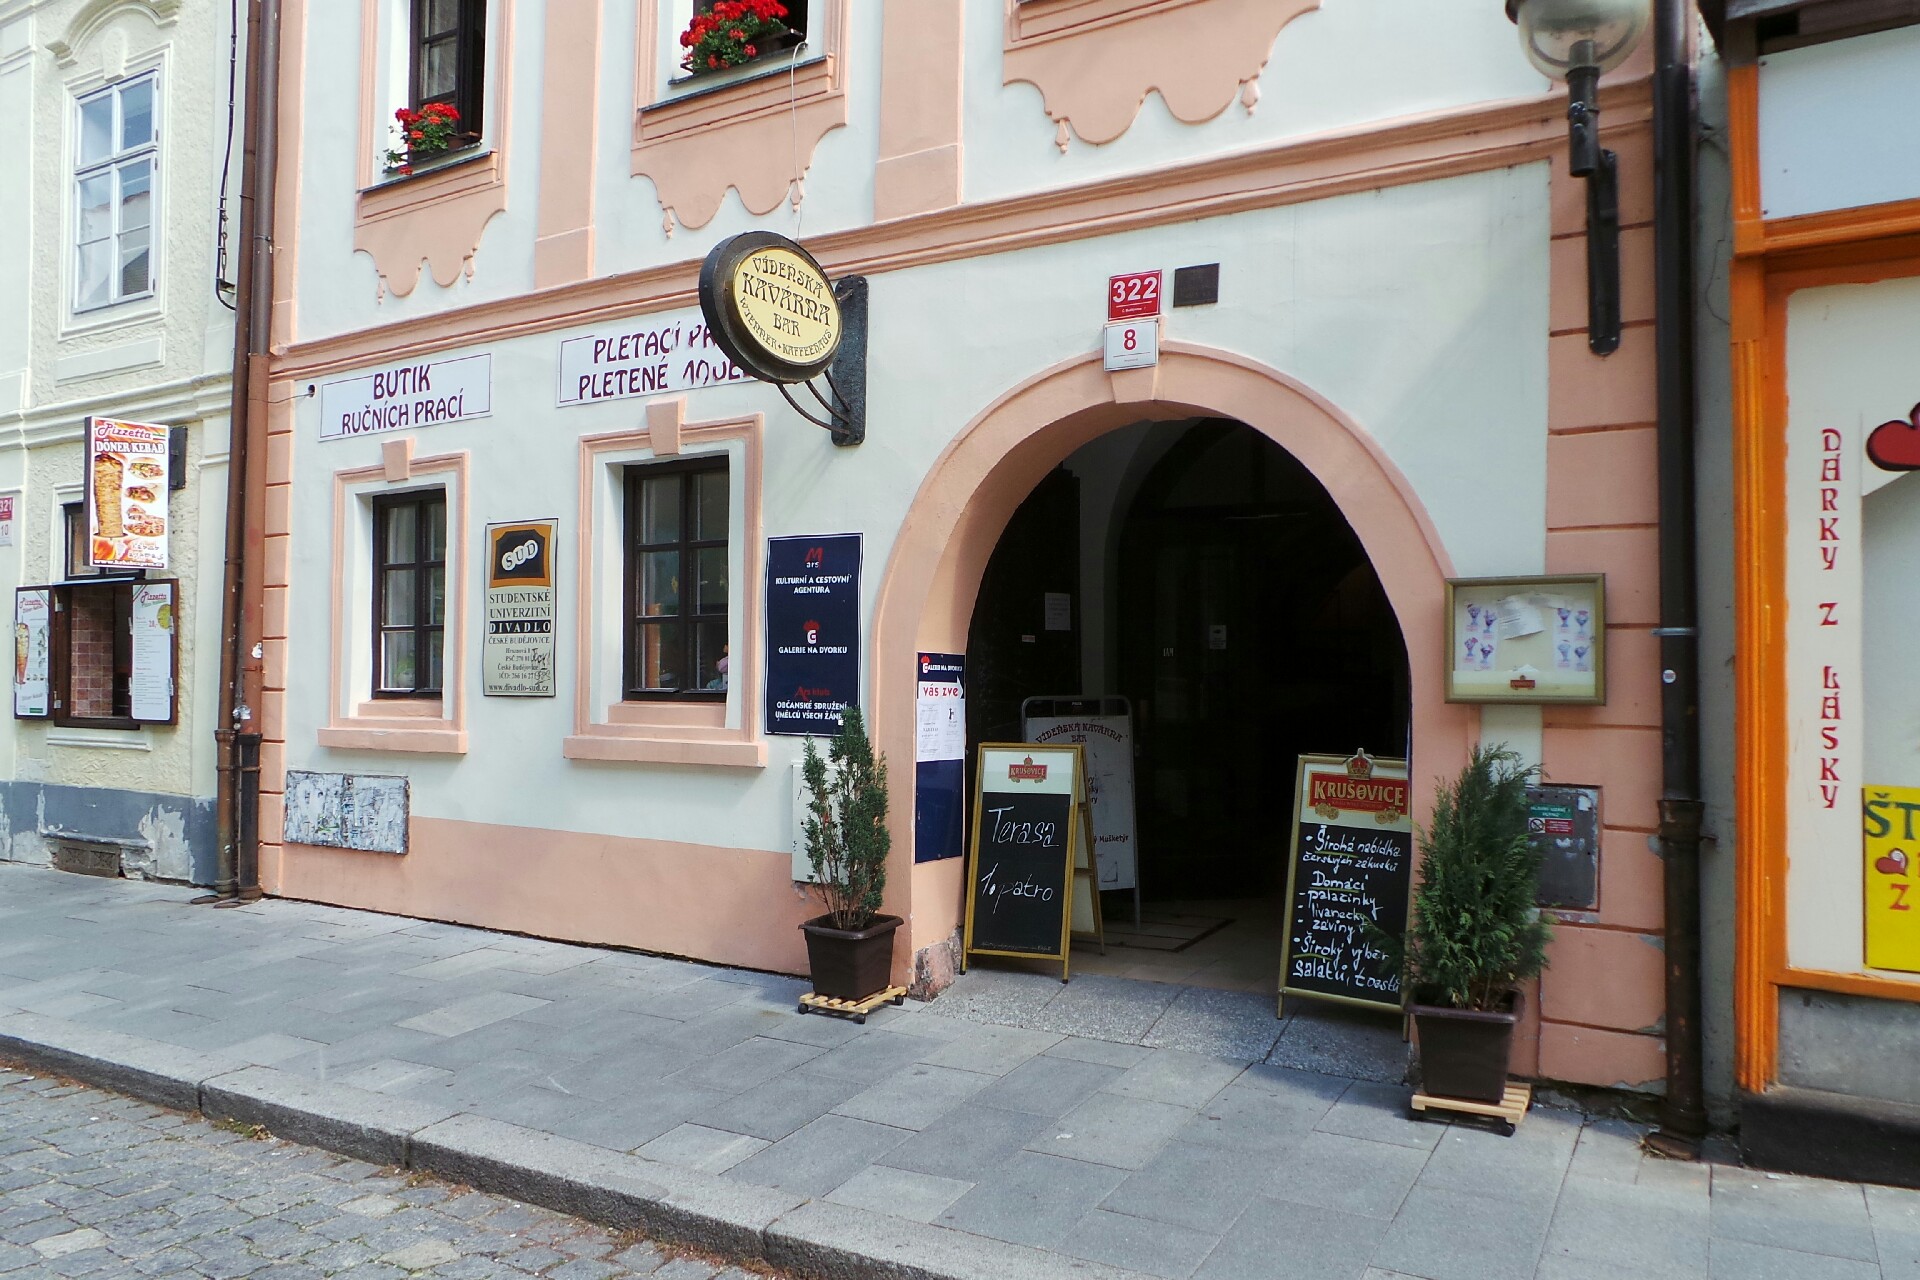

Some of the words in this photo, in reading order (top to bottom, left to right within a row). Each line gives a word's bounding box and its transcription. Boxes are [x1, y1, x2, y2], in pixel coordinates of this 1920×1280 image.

[752, 255, 824, 299] VÍDEŇSKÁ
[742, 271, 831, 327] KAVÁRNA
[1112, 276, 1158, 303] 322
[773, 312, 801, 338] BAR
[593, 321, 681, 364] PLETACÍ
[1123, 329, 1137, 351] 8
[373, 364, 431, 401] BUTIK
[579, 356, 669, 400] PLETENÉ
[342, 400, 409, 435] RUČNÍCH
[414, 388, 464, 424] PRACÍ
[97, 422, 151, 439] Pizzetta
[95, 439, 131, 453] DÖNER
[132, 442, 165, 454] KEBAB
[1818, 428, 1842, 570] DÁRKY
[505, 543, 536, 568] SUD
[775, 574, 807, 585] KULTURNÍ
[815, 573, 850, 584] CESTOVNÍ
[793, 585, 831, 595] AGENTURA
[489, 588, 551, 604] STUDENTSKÉ
[489, 603, 551, 618] UNIVERZITNÍ
[489, 621, 551, 633] DIVADLO
[778, 646, 806, 654] GALERIE
[807, 646, 818, 654] NA
[819, 646, 848, 654] DVORKU
[923, 683, 939, 697] vás
[942, 686, 959, 697] zve
[776, 699, 813, 710] OBČANSKÉ
[814, 700, 848, 710] SDRUŽENÍ
[802, 709, 823, 719] VŠECH
[1071, 734, 1087, 743] BAR
[1082, 722, 1123, 743] KAVÁRNA
[1818, 660, 1842, 809] LÁSKY
[1314, 780, 1404, 807] KRUŠOVICE
[988, 806, 1060, 848] Terasa
[1315, 825, 1355, 852] Široká
[1357, 836, 1402, 858] nabídka
[1311, 870, 1369, 891] Domácí
[993, 873, 1054, 915] patro
[1312, 920, 1356, 944] záviny
[1300, 930, 1345, 970] Široký
